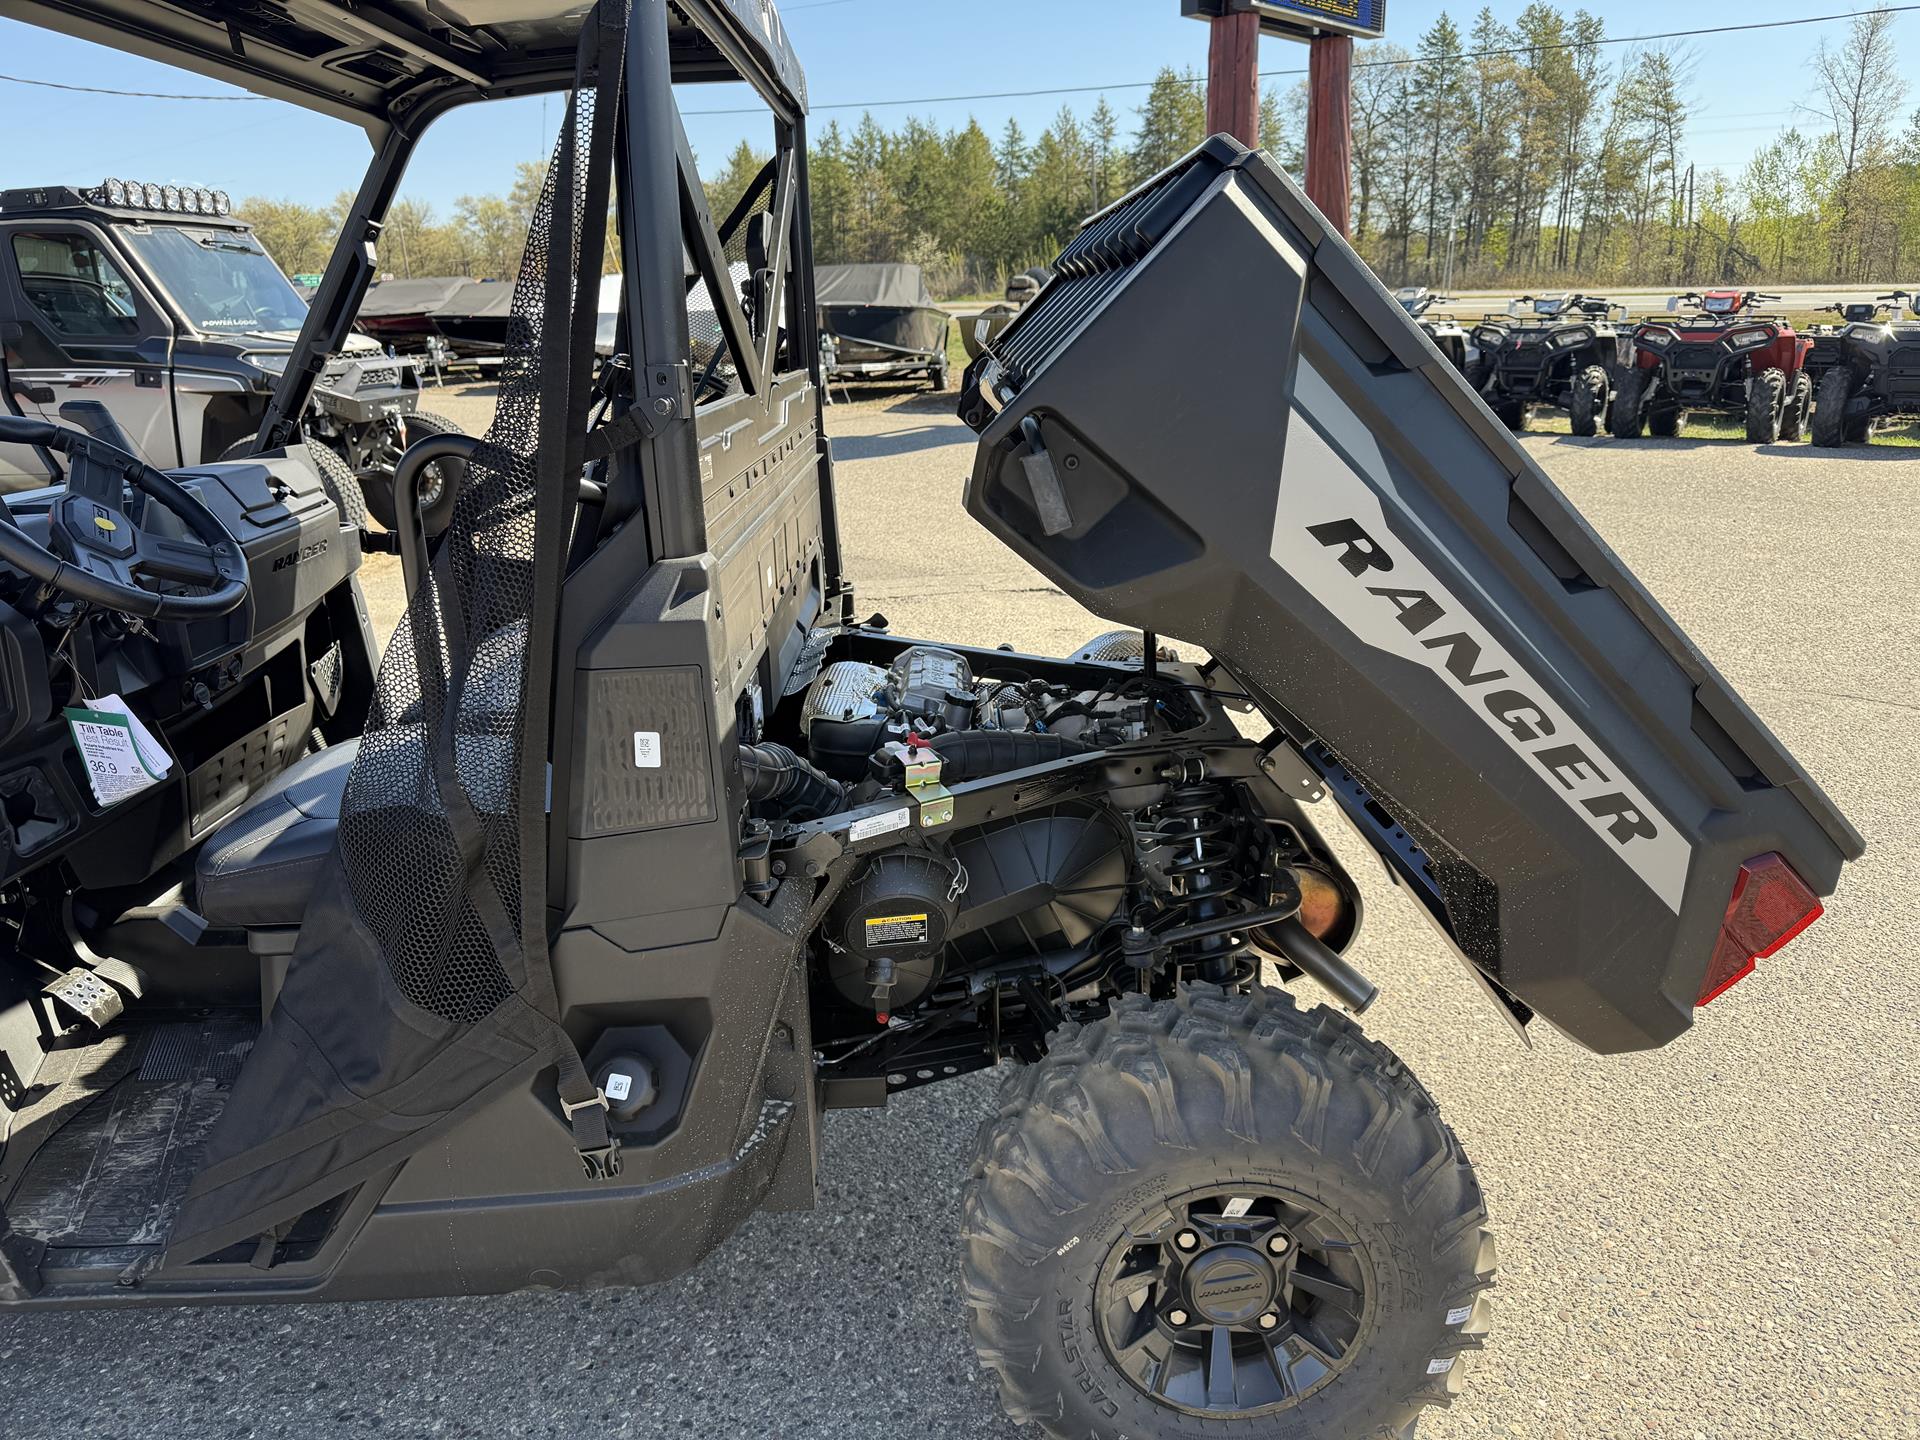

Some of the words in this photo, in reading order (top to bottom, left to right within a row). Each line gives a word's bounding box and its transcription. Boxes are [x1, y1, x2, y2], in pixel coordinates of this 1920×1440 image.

[272, 539, 328, 573] RANGER
[1305, 517, 1658, 845] RANGER
[79, 723, 97, 735] Tilt
[96, 725, 124, 738] Table
[80, 732, 101, 743] Test
[101, 735, 130, 747] Result
[90, 760, 118, 775] 36.9
[1199, 1283, 1262, 1298] RANGER
[1057, 1298, 1120, 1418] CARLSTAR
